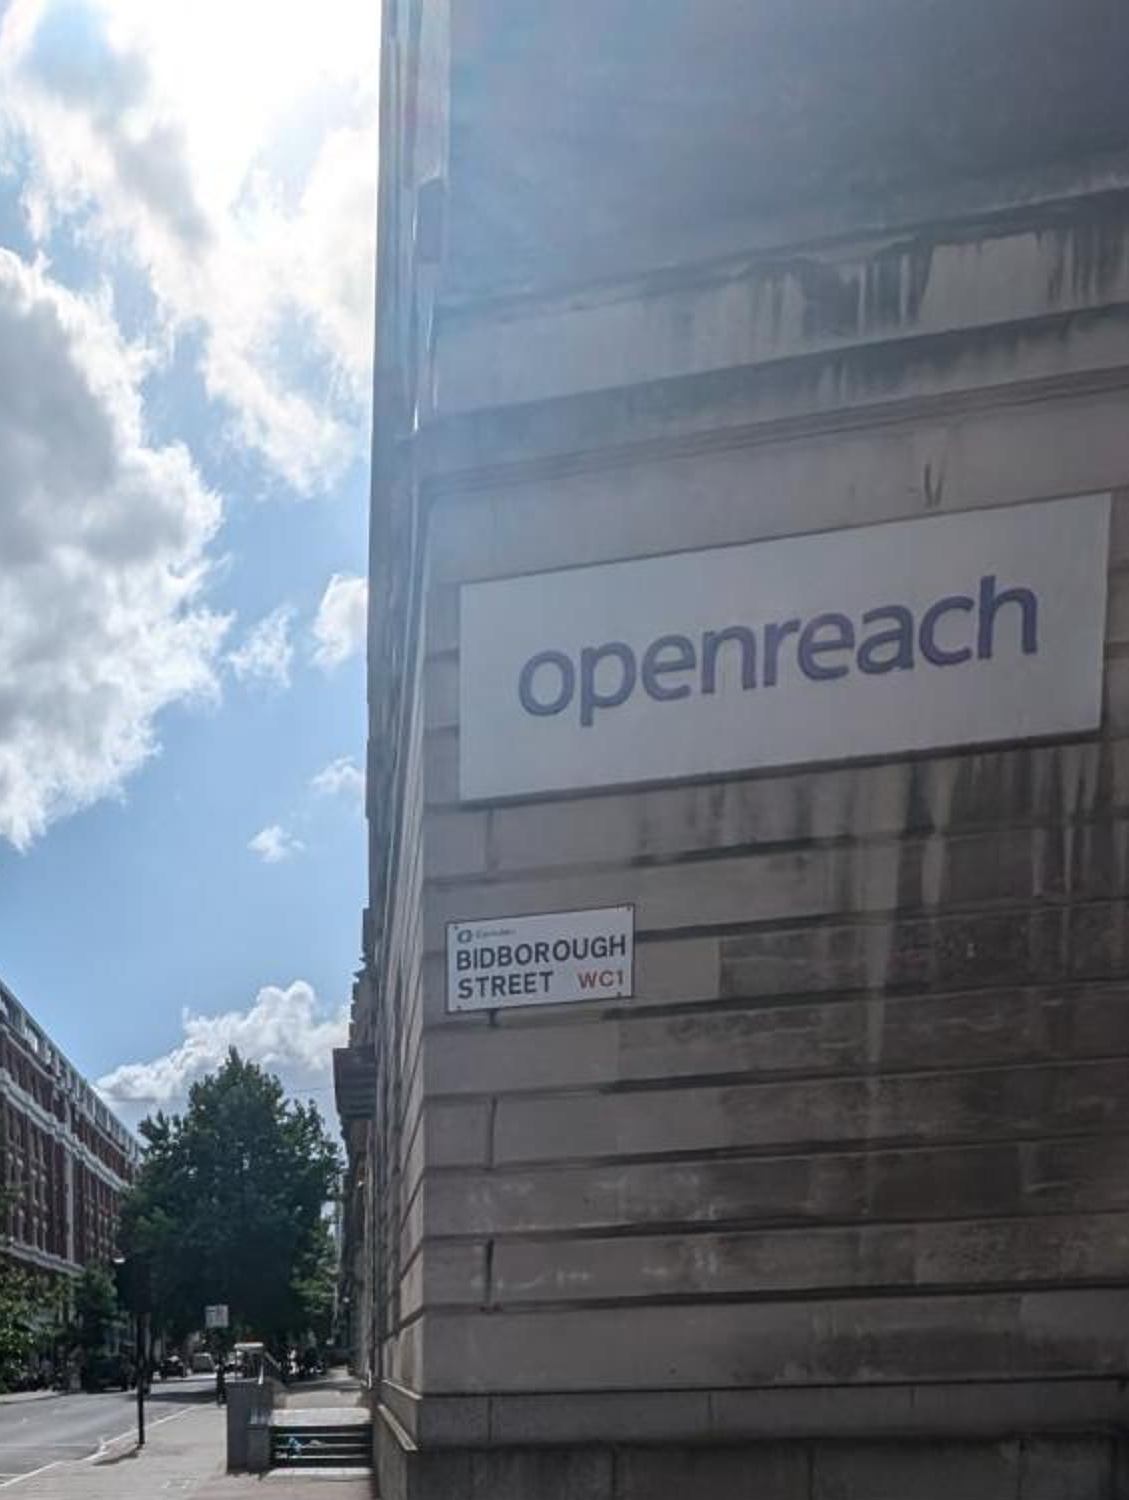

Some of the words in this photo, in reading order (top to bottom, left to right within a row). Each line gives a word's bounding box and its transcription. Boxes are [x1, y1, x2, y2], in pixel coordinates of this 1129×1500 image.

[519, 575, 1039, 728] openreach
[456, 934, 627, 971] BIDBOROUGH
[458, 970, 554, 999] STREET
[577, 969, 624, 990] WC1
